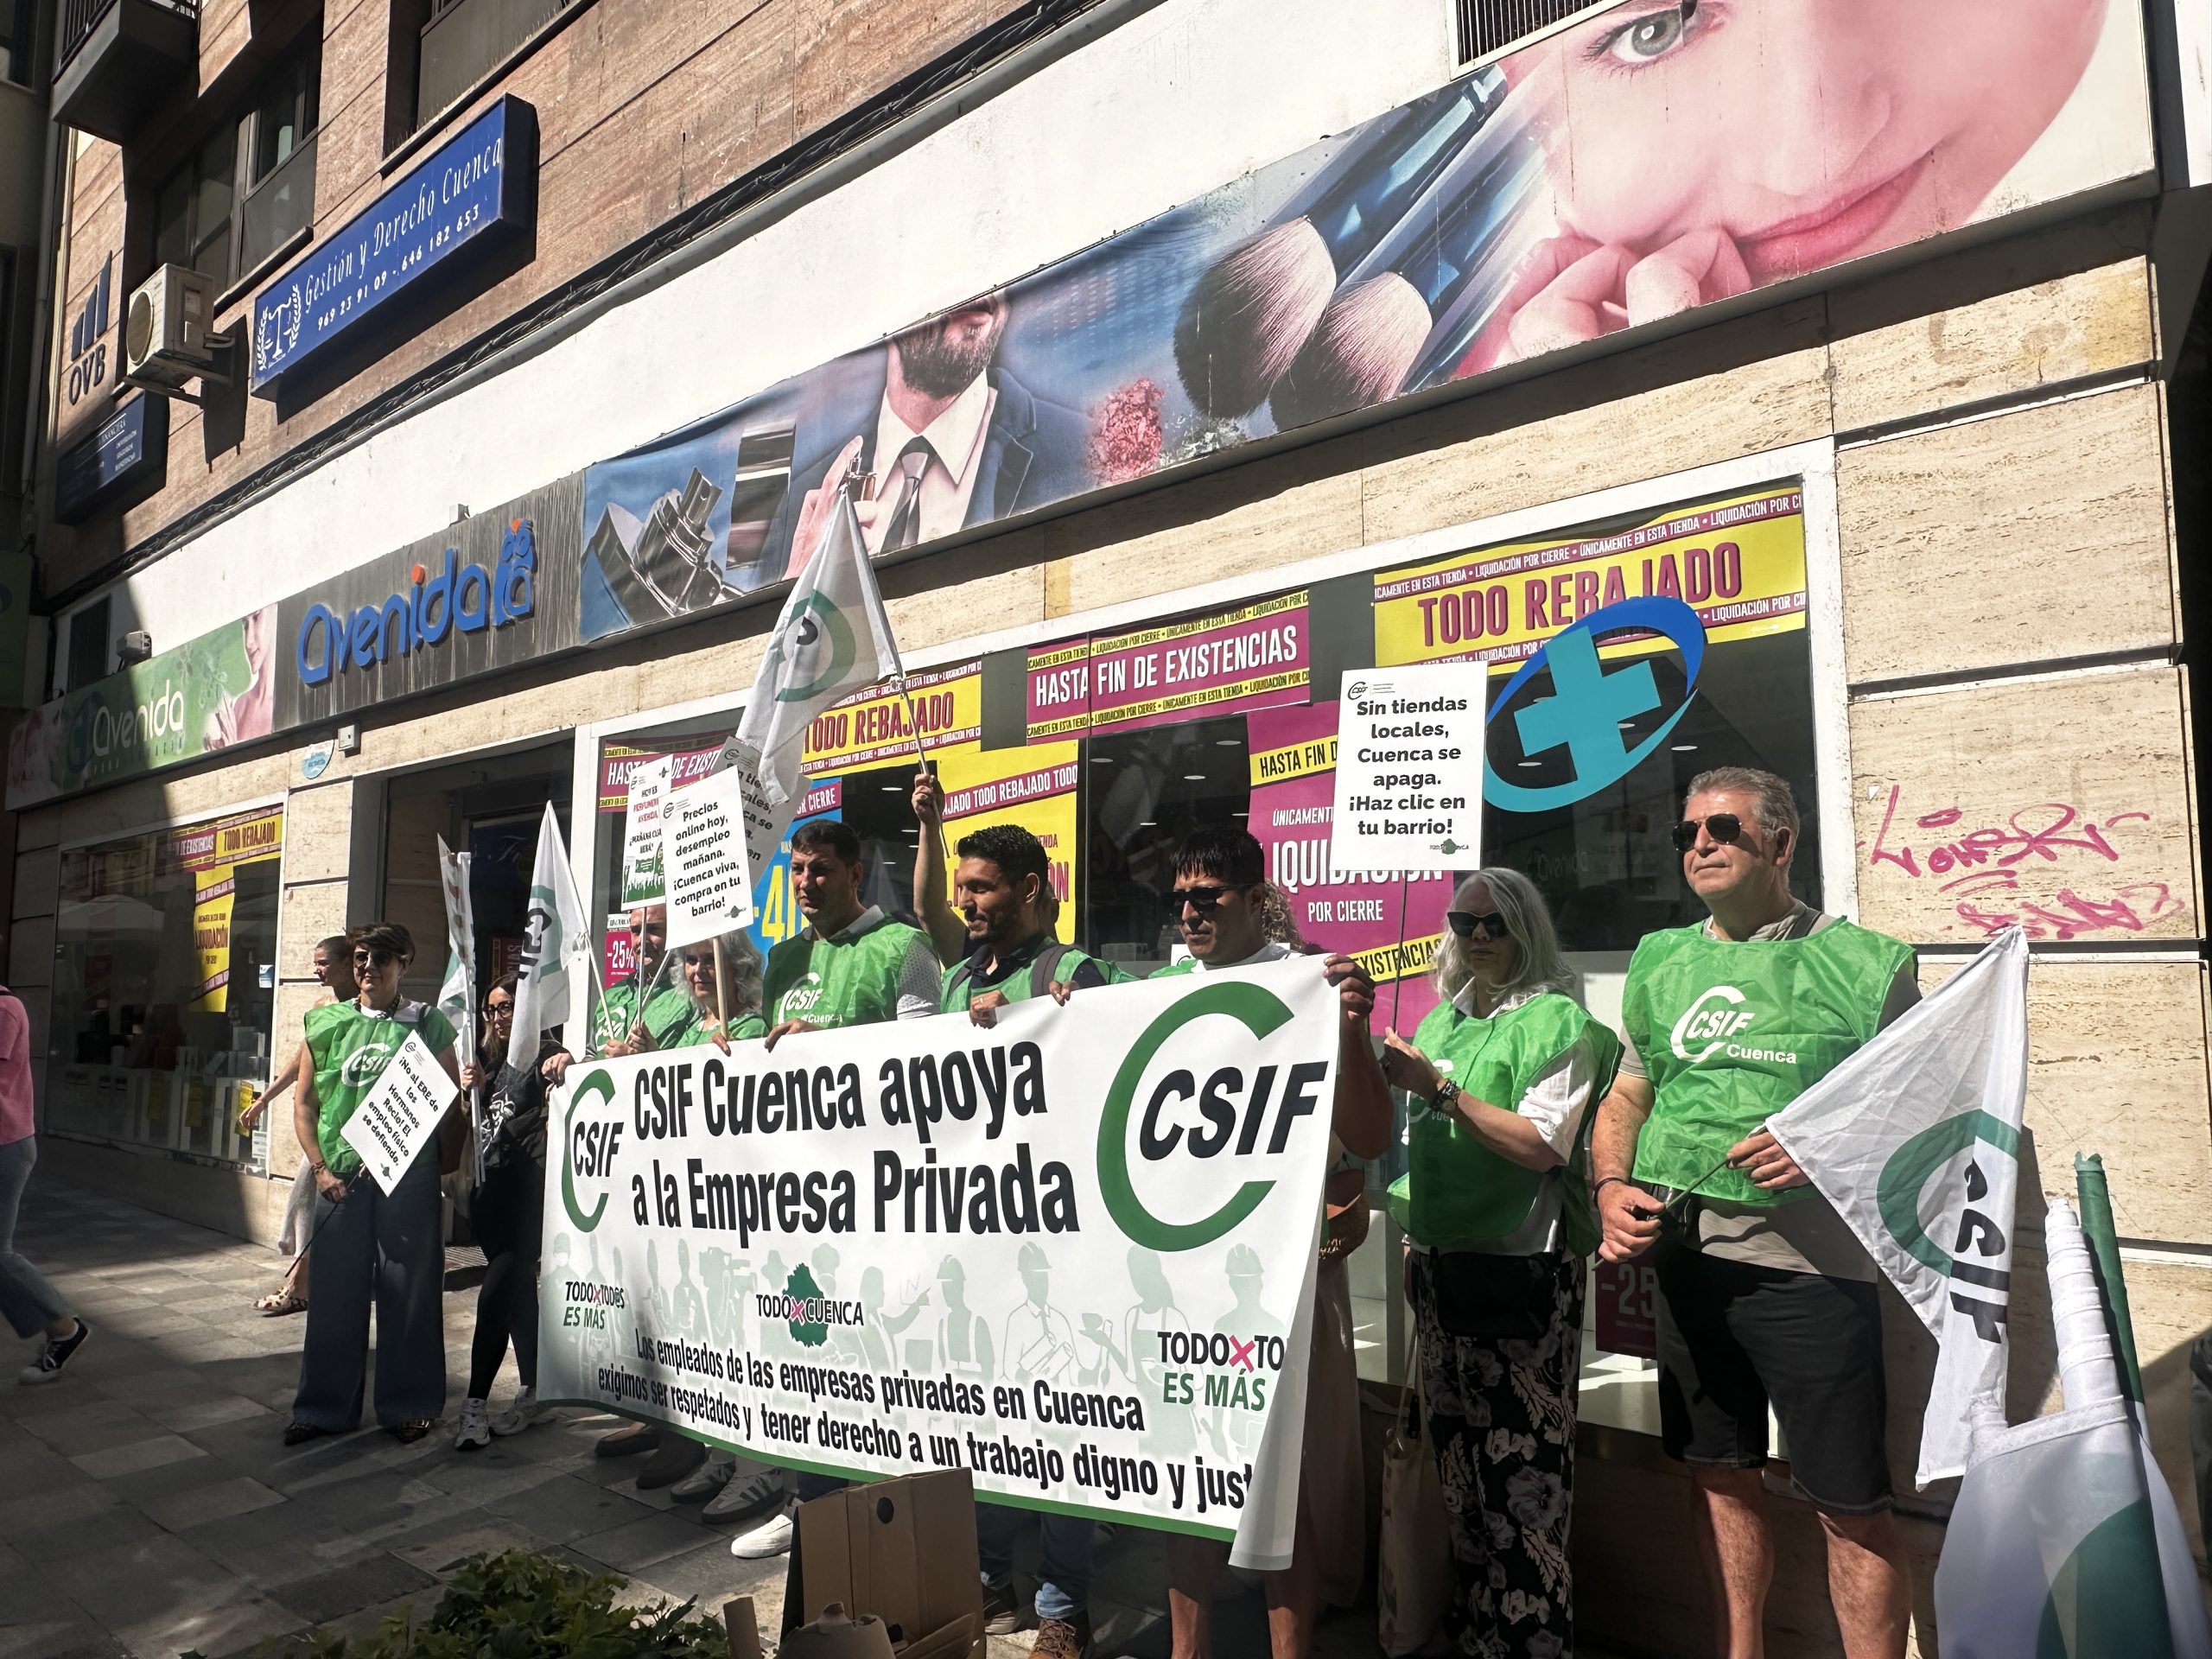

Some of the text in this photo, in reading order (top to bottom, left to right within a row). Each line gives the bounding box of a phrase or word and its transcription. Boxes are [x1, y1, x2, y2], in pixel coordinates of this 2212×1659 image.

[306, 137, 502, 314] Gestión y Derecho Cuenca
[318, 204, 479, 331] 969 23 91 09 646 182 653
[69, 343, 105, 405] OVB
[1411, 582, 1421, 592] EN
[1422, 575, 1440, 589] ESTA
[1442, 569, 1467, 585] TIENDA
[1475, 556, 1522, 578] LIQUIDACIÓN
[1523, 555, 1540, 569] POR
[1541, 547, 1570, 564] CIERRE
[1580, 534, 1632, 557] ÚNICAMENTE
[1634, 529, 1645, 544] EN
[1647, 524, 1667, 540] ESTA
[1669, 517, 1700, 536] TIENDA
[1710, 499, 1768, 526] LIQUIDACIÓN
[1770, 495, 1789, 513] POR
[1418, 542, 1741, 647] TODO REBAJADO
[1712, 596, 1790, 622] LIQUIDACIÓN POR
[1036, 625, 1297, 707] HASTA FIN DE EXISTENCIAS
[1357, 696, 1467, 716] Sin tiendas
[804, 713, 848, 754] TODO
[855, 691, 954, 745] REBAJADO
[1371, 721, 1449, 740] locales,
[1260, 745, 1325, 778] HASTA FIN
[1357, 747, 1461, 763] Cuenca se
[973, 785, 996, 807] TODO
[999, 772, 1050, 801] REBAJADO
[1053, 765, 1077, 788] TODO
[1373, 773, 1441, 790] apaga.
[683, 802, 718, 822] Precios
[808, 787, 836, 810] CIERRE
[1349, 794, 1465, 811] ¡Haz clic en
[676, 822, 705, 841] online
[708, 814, 728, 830] hoy,
[758, 819, 772, 830] se
[1273, 806, 1333, 827] ÚNICAMENT
[1358, 818, 1452, 836] tu barrio!
[676, 830, 730, 856] desempleo
[683, 849, 725, 871] mañana.
[674, 861, 739, 891] ¡Cuenca viva,
[675, 875, 741, 906] compra en tu
[692, 896, 725, 917] barrio!
[1308, 899, 1383, 922] POR CIERRE
[607, 940, 634, 969] -25%
[1353, 938, 1441, 976] XISTENCIA
[786, 988, 823, 1010] CSIF
[1687, 1010, 1756, 1039] CSIF
[1726, 1044, 1797, 1064] Cuenca
[389, 1084, 420, 1128] Hermanos
[406, 1086, 417, 1103] los
[410, 1072, 418, 1084] al
[416, 1081, 432, 1101] ERE
[429, 1098, 439, 1112] de
[633, 1040, 1048, 1145] CSIF Cuenca apoya
[362, 1115, 372, 1126] se
[1139, 1060, 1329, 1161] CSIF
[368, 1101, 410, 1157] empleo físico
[572, 1122, 624, 1178] CSIF
[632, 1142, 1081, 1249] a la Empresa Privada
[563, 1303, 606, 1330] ES MÁS
[635, 1328, 1145, 1432] Los empleados de las empresas privadas en Cuenca
[1164, 1368, 1266, 1412] ES MÁS
[598, 1363, 648, 1402] exigimos
[651, 1379, 668, 1408] ser
[671, 1387, 741, 1440] respetados
[743, 1406, 752, 1441] y
[760, 1402, 811, 1445] tener
[817, 1410, 900, 1460] derecho
[909, 1433, 925, 1463] a
[930, 1434, 961, 1468] un
[967, 1430, 1065, 1491] trabajo
[1073, 1443, 1159, 1501] digno
[1167, 1462, 1185, 1510] y
